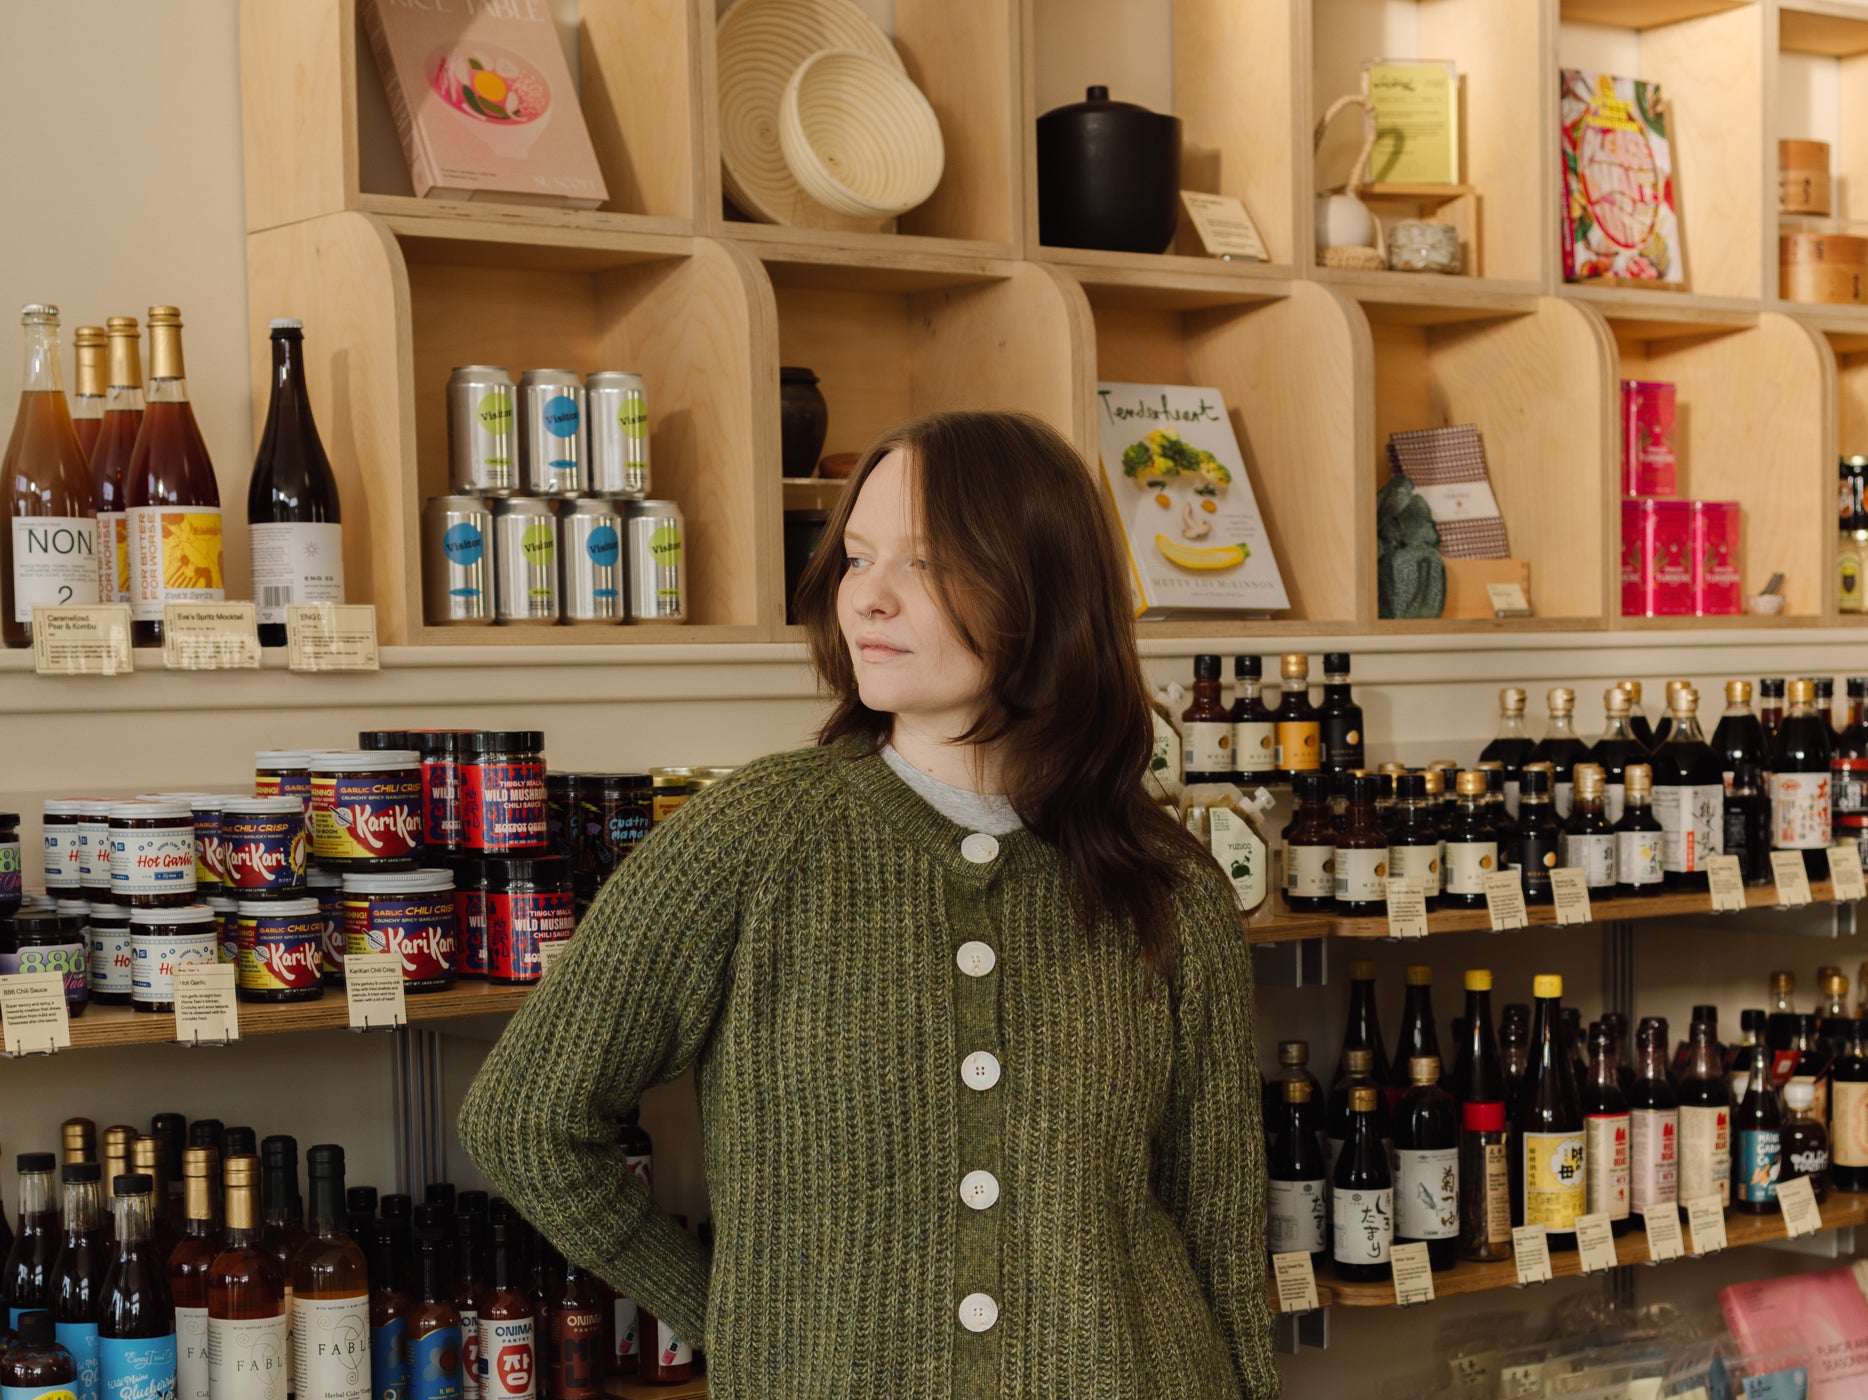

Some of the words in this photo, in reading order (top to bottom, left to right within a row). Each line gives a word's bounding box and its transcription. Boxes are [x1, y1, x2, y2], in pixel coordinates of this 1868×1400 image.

[546, 412, 578, 425] Visitor
[28, 529, 92, 554] NON
[139, 513, 148, 566] BITTER
[147, 513, 157, 566] WORSE
[446, 539, 481, 552] Visitor
[141, 569, 149, 600] FOR
[150, 570, 159, 600] FOR
[195, 613, 214, 621] Spritz
[372, 785, 399, 793] CHILI
[484, 789, 509, 802] WILD
[259, 824, 288, 832] CRISP
[355, 804, 422, 848] KariKari
[136, 854, 161, 868] Hot
[163, 852, 192, 868] Garlic
[224, 842, 286, 880] KariKari
[405, 907, 432, 915] CHILI
[514, 919, 538, 931] WILD
[388, 927, 454, 971] KariKari
[19, 949, 86, 974] 886
[1375, 1195, 1390, 1231] しろ
[1361, 1205, 1381, 1258] たまり
[567, 1315, 600, 1326] ONIM
[495, 1323, 533, 1337] ONIMA
[236, 1356, 284, 1372] FABL
[503, 1353, 530, 1386] 장
[324, 1391, 345, 1399] Herbal
[346, 1390, 360, 1398] Cider
